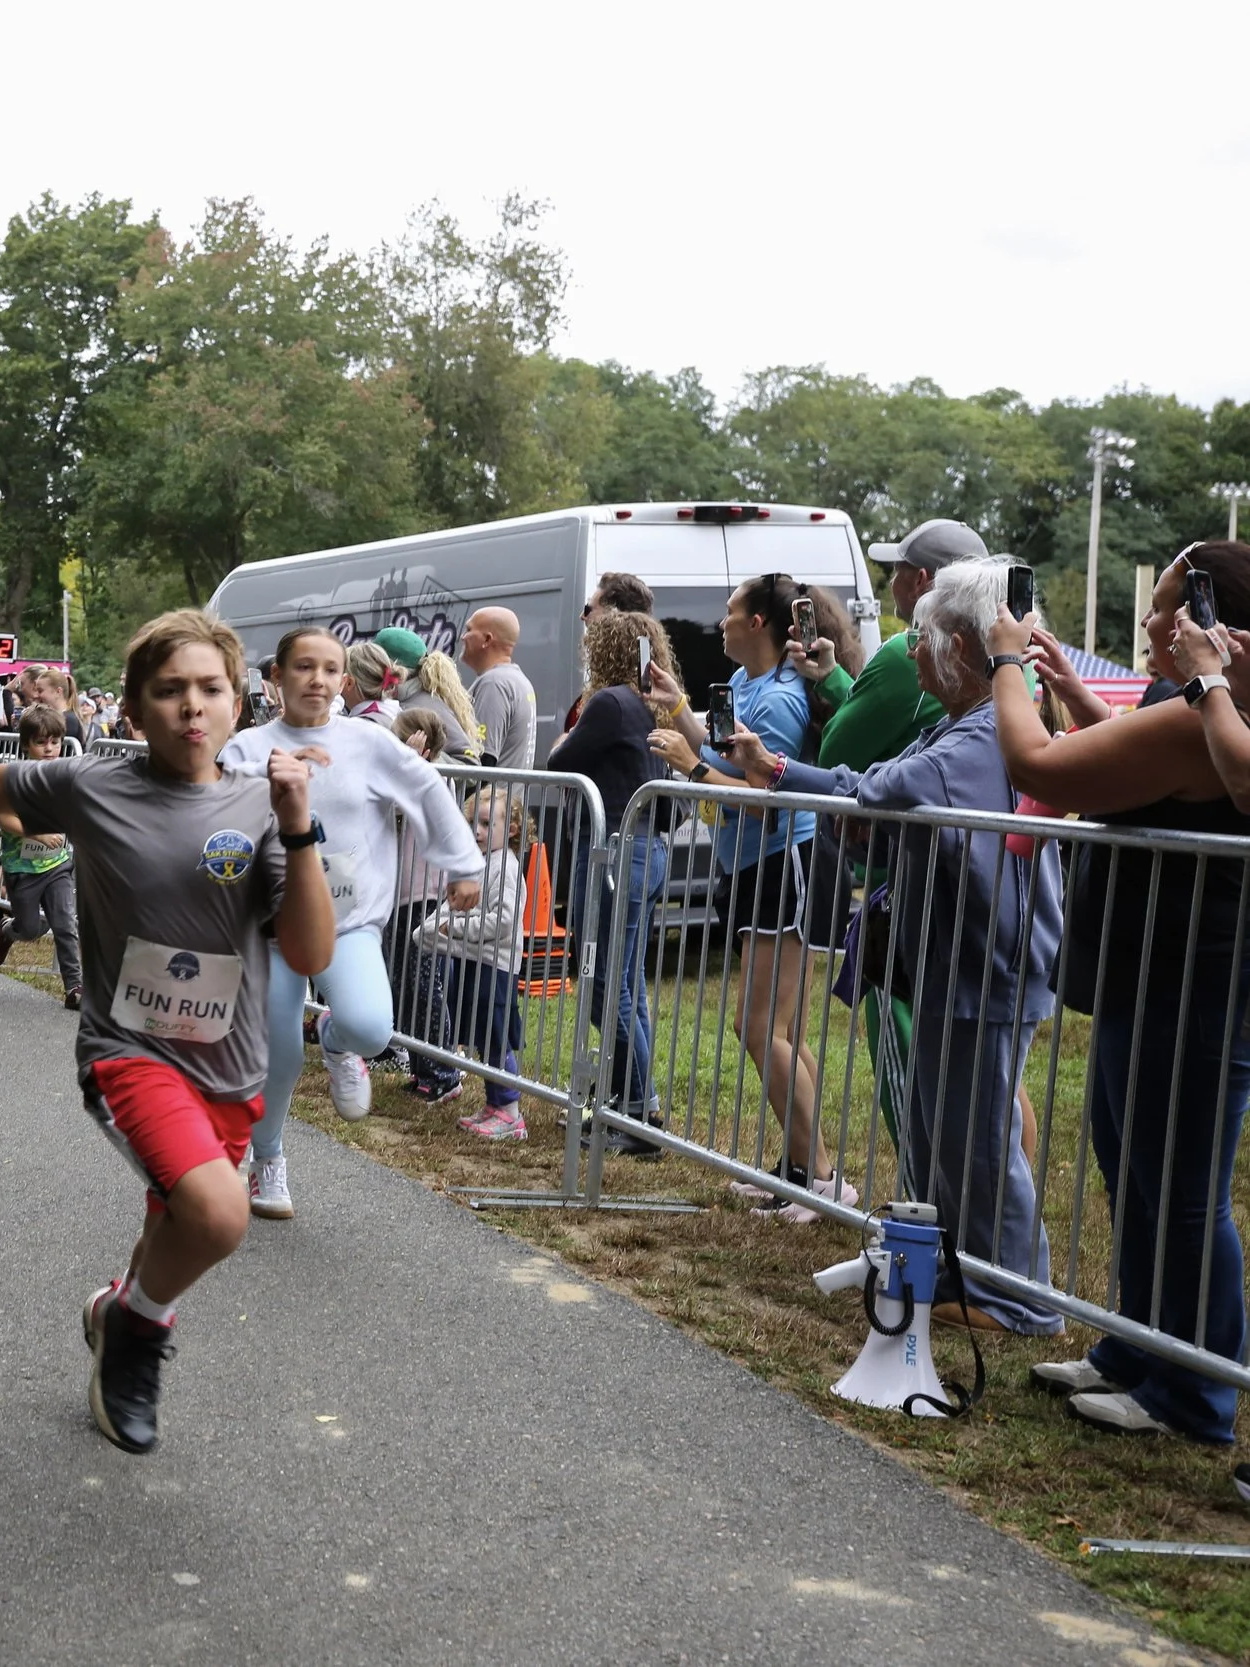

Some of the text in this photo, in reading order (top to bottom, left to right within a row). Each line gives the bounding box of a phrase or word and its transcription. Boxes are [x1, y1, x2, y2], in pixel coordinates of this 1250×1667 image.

[25, 844, 44, 852] FUN
[331, 885, 353, 898] UN
[125, 984, 227, 1020] FUN RUN
[905, 1334, 917, 1367] PYLE
